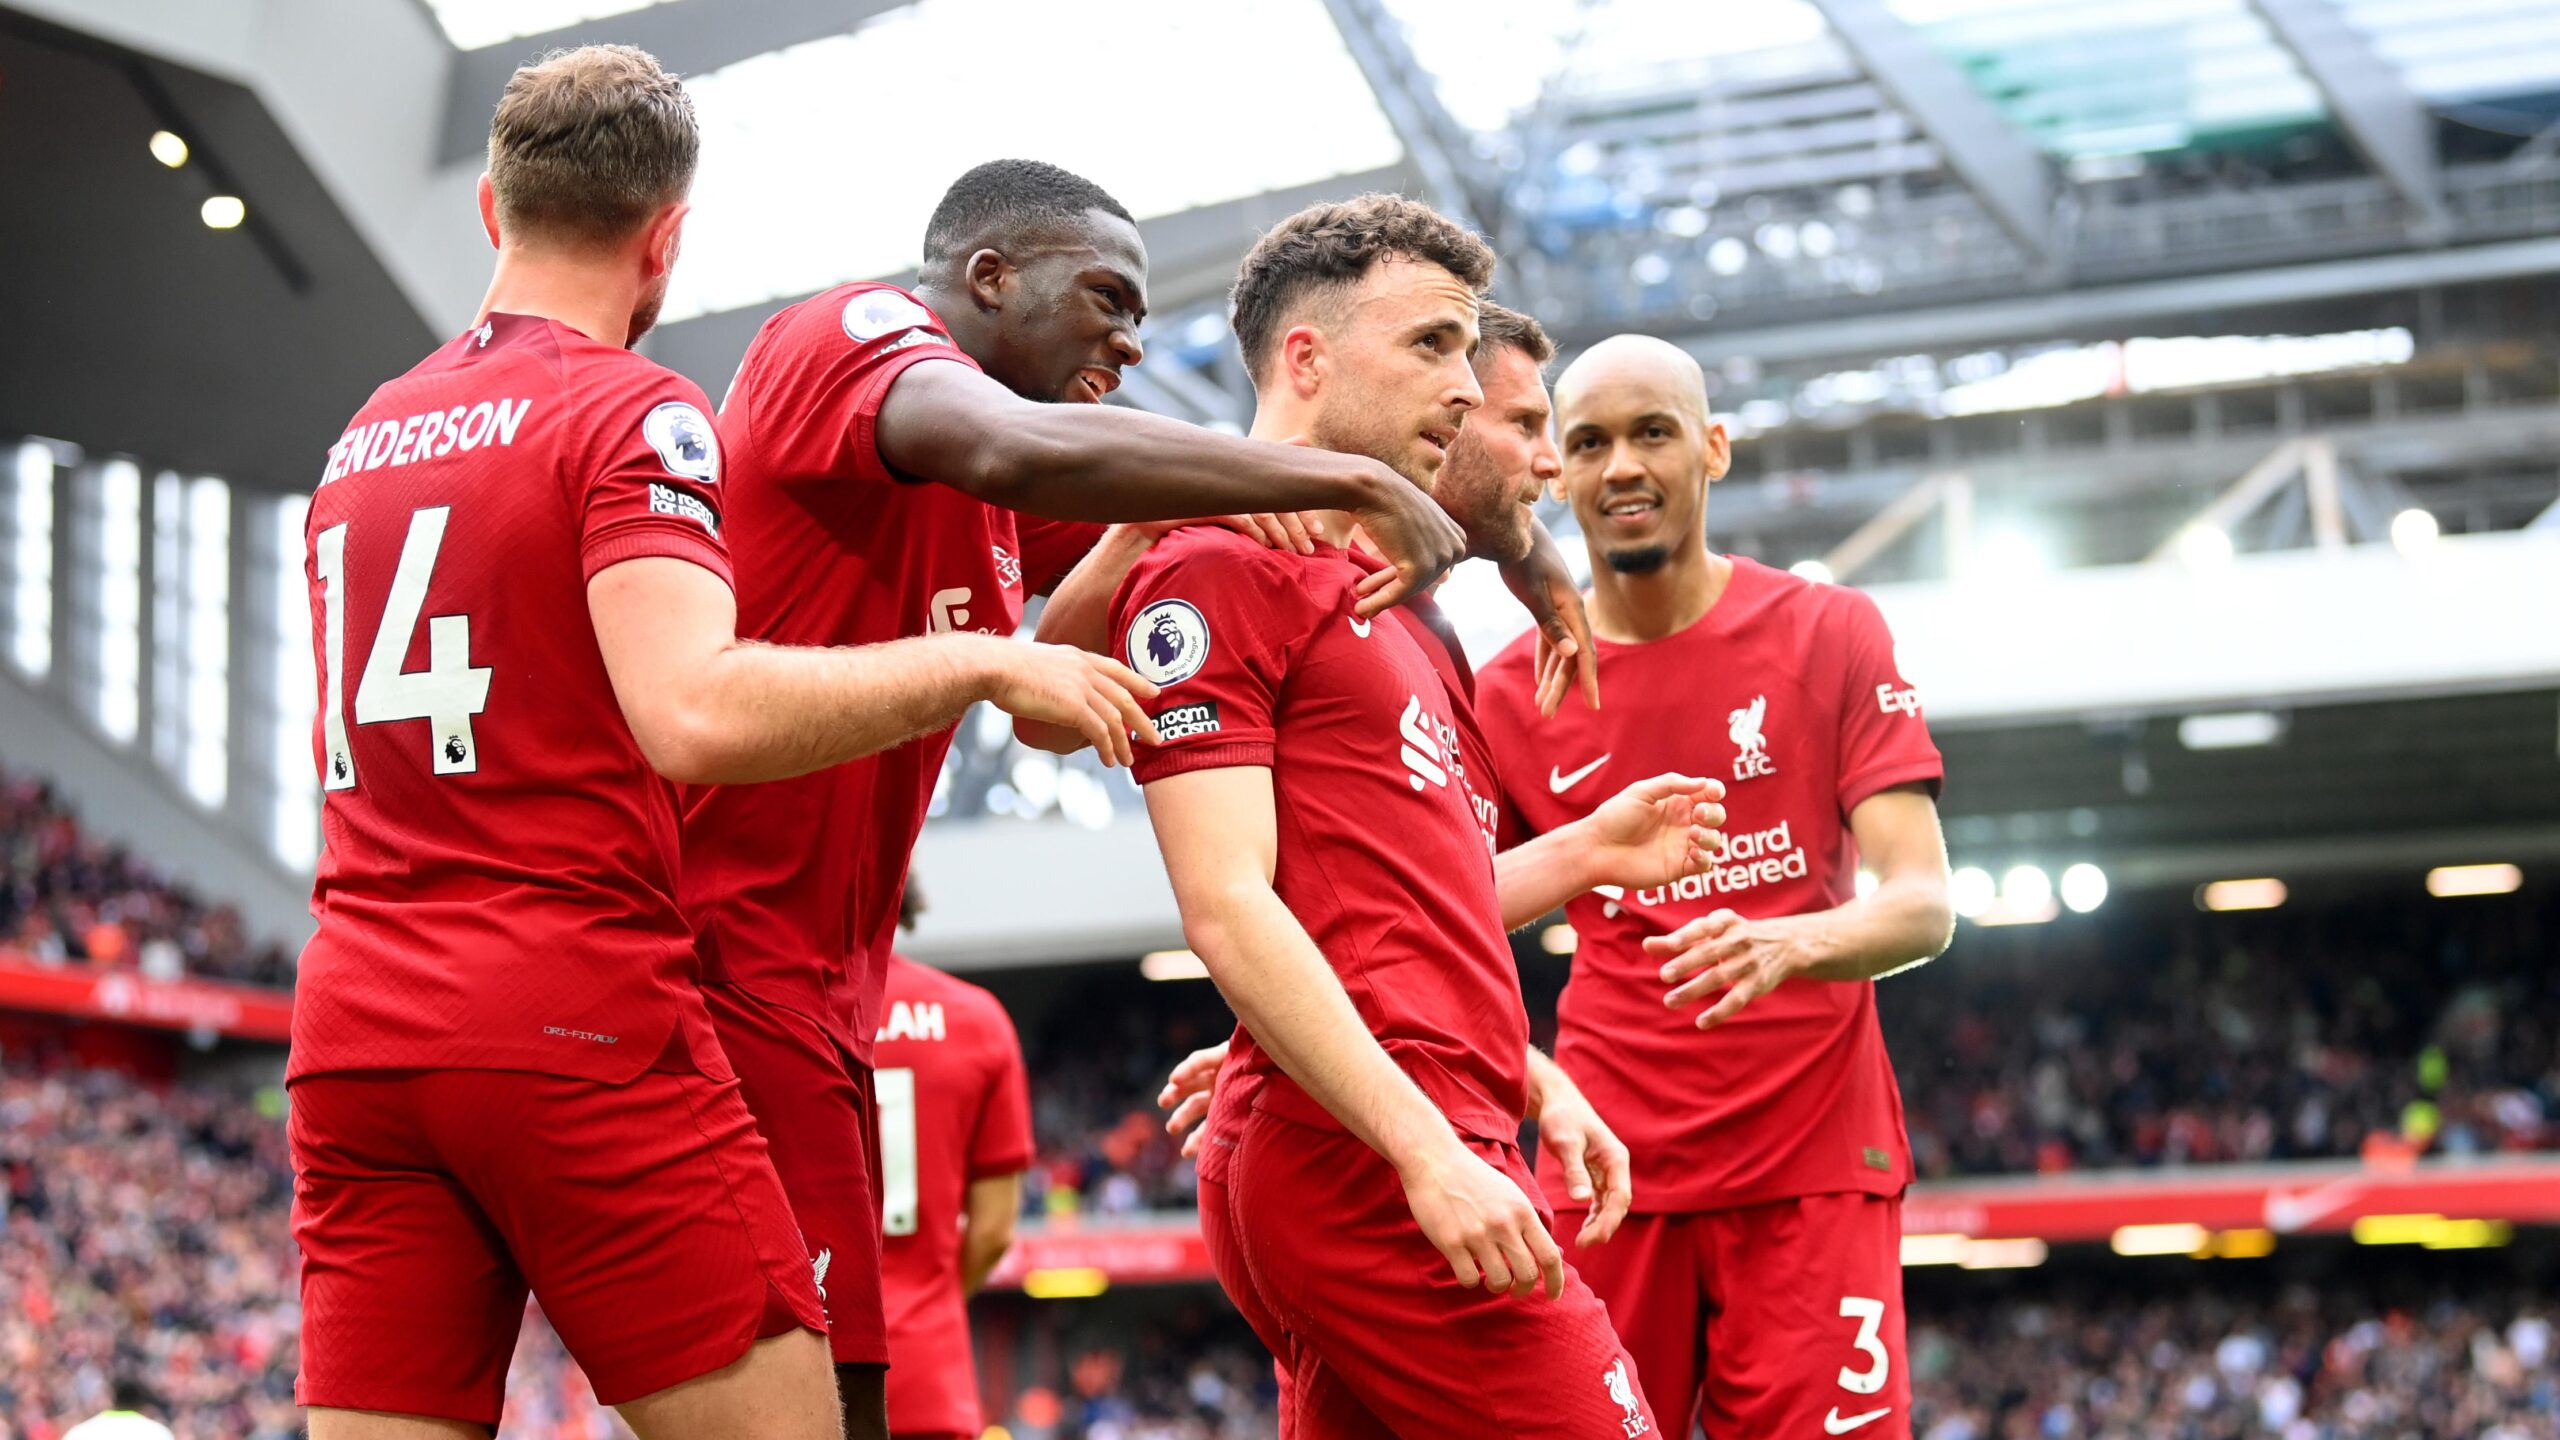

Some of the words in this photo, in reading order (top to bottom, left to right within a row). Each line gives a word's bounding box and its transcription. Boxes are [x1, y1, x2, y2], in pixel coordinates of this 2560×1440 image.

[649, 483, 676, 502] No
[677, 493, 714, 527] room
[678, 505, 719, 541] racm
[317, 505, 494, 792] 14
[1165, 662, 1187, 677] Premier
[1185, 635, 1198, 663] League
[1160, 706, 1210, 728] room
[1160, 720, 1220, 742] racism
[1837, 1297, 1889, 1394] 3
